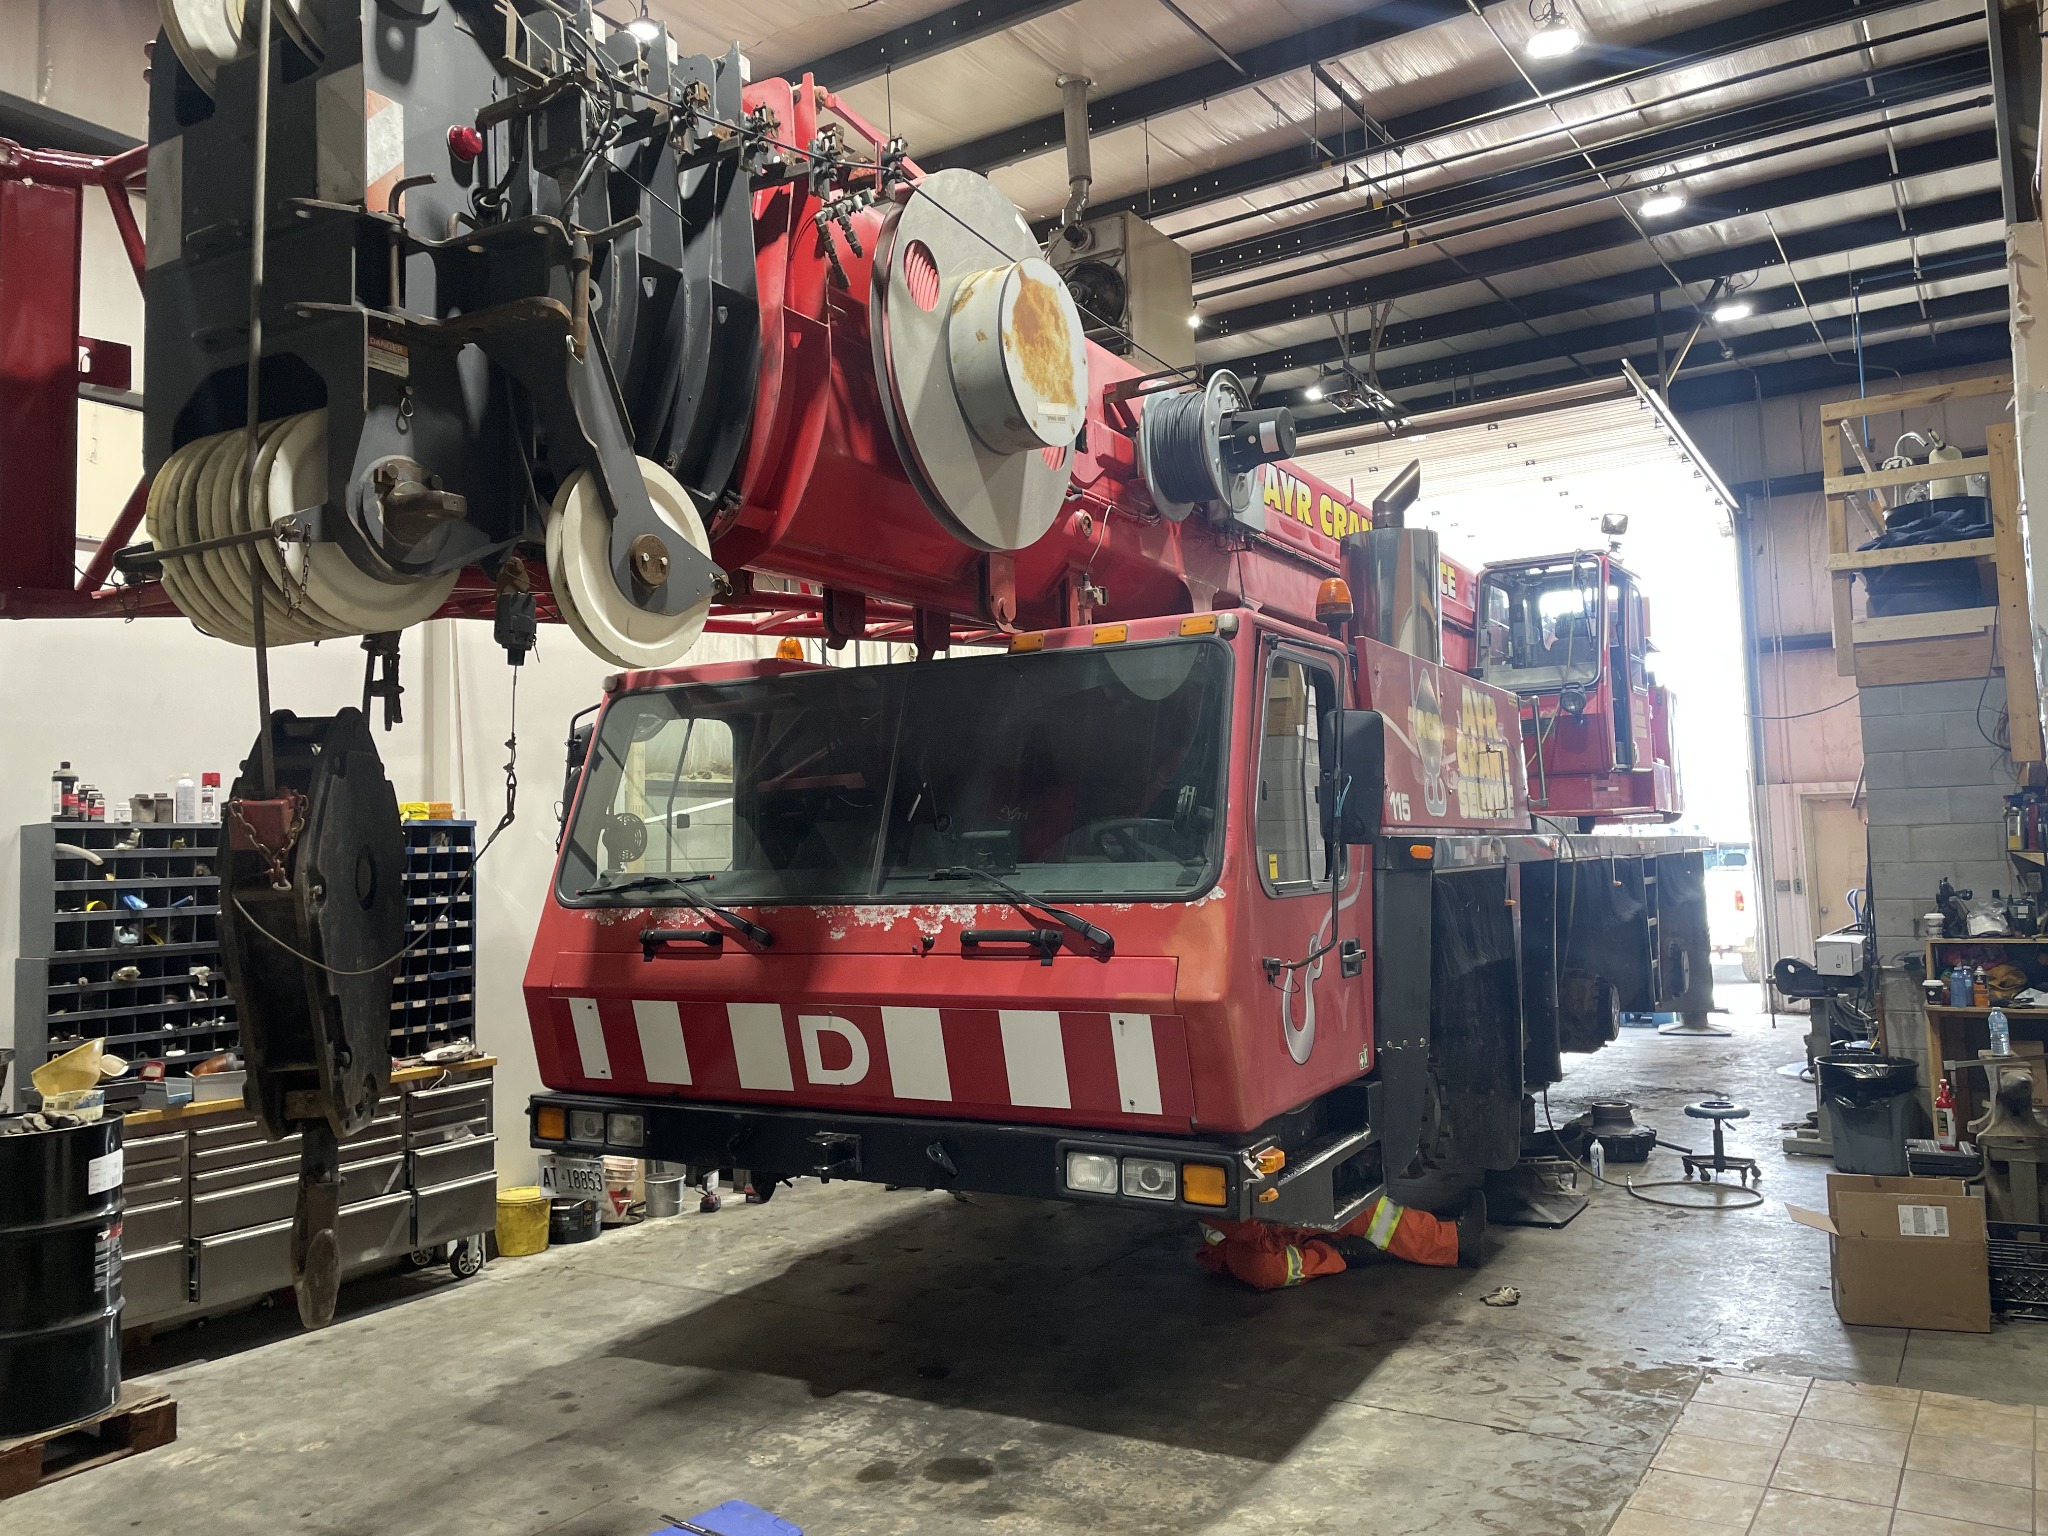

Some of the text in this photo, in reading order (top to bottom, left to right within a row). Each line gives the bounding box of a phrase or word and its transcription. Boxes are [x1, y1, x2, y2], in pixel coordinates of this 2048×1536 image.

[370, 336, 403, 353] DANGER
[1263, 462, 1313, 529] AYR
[1319, 493, 1372, 541] CRA
[1461, 685, 1499, 741] AYR
[1457, 729, 1511, 786] CRANE
[1389, 791, 1411, 822] 115
[1457, 779, 1515, 819] SERVICE
[797, 1014, 870, 1086] D
[543, 1167, 603, 1191] AT 18853
